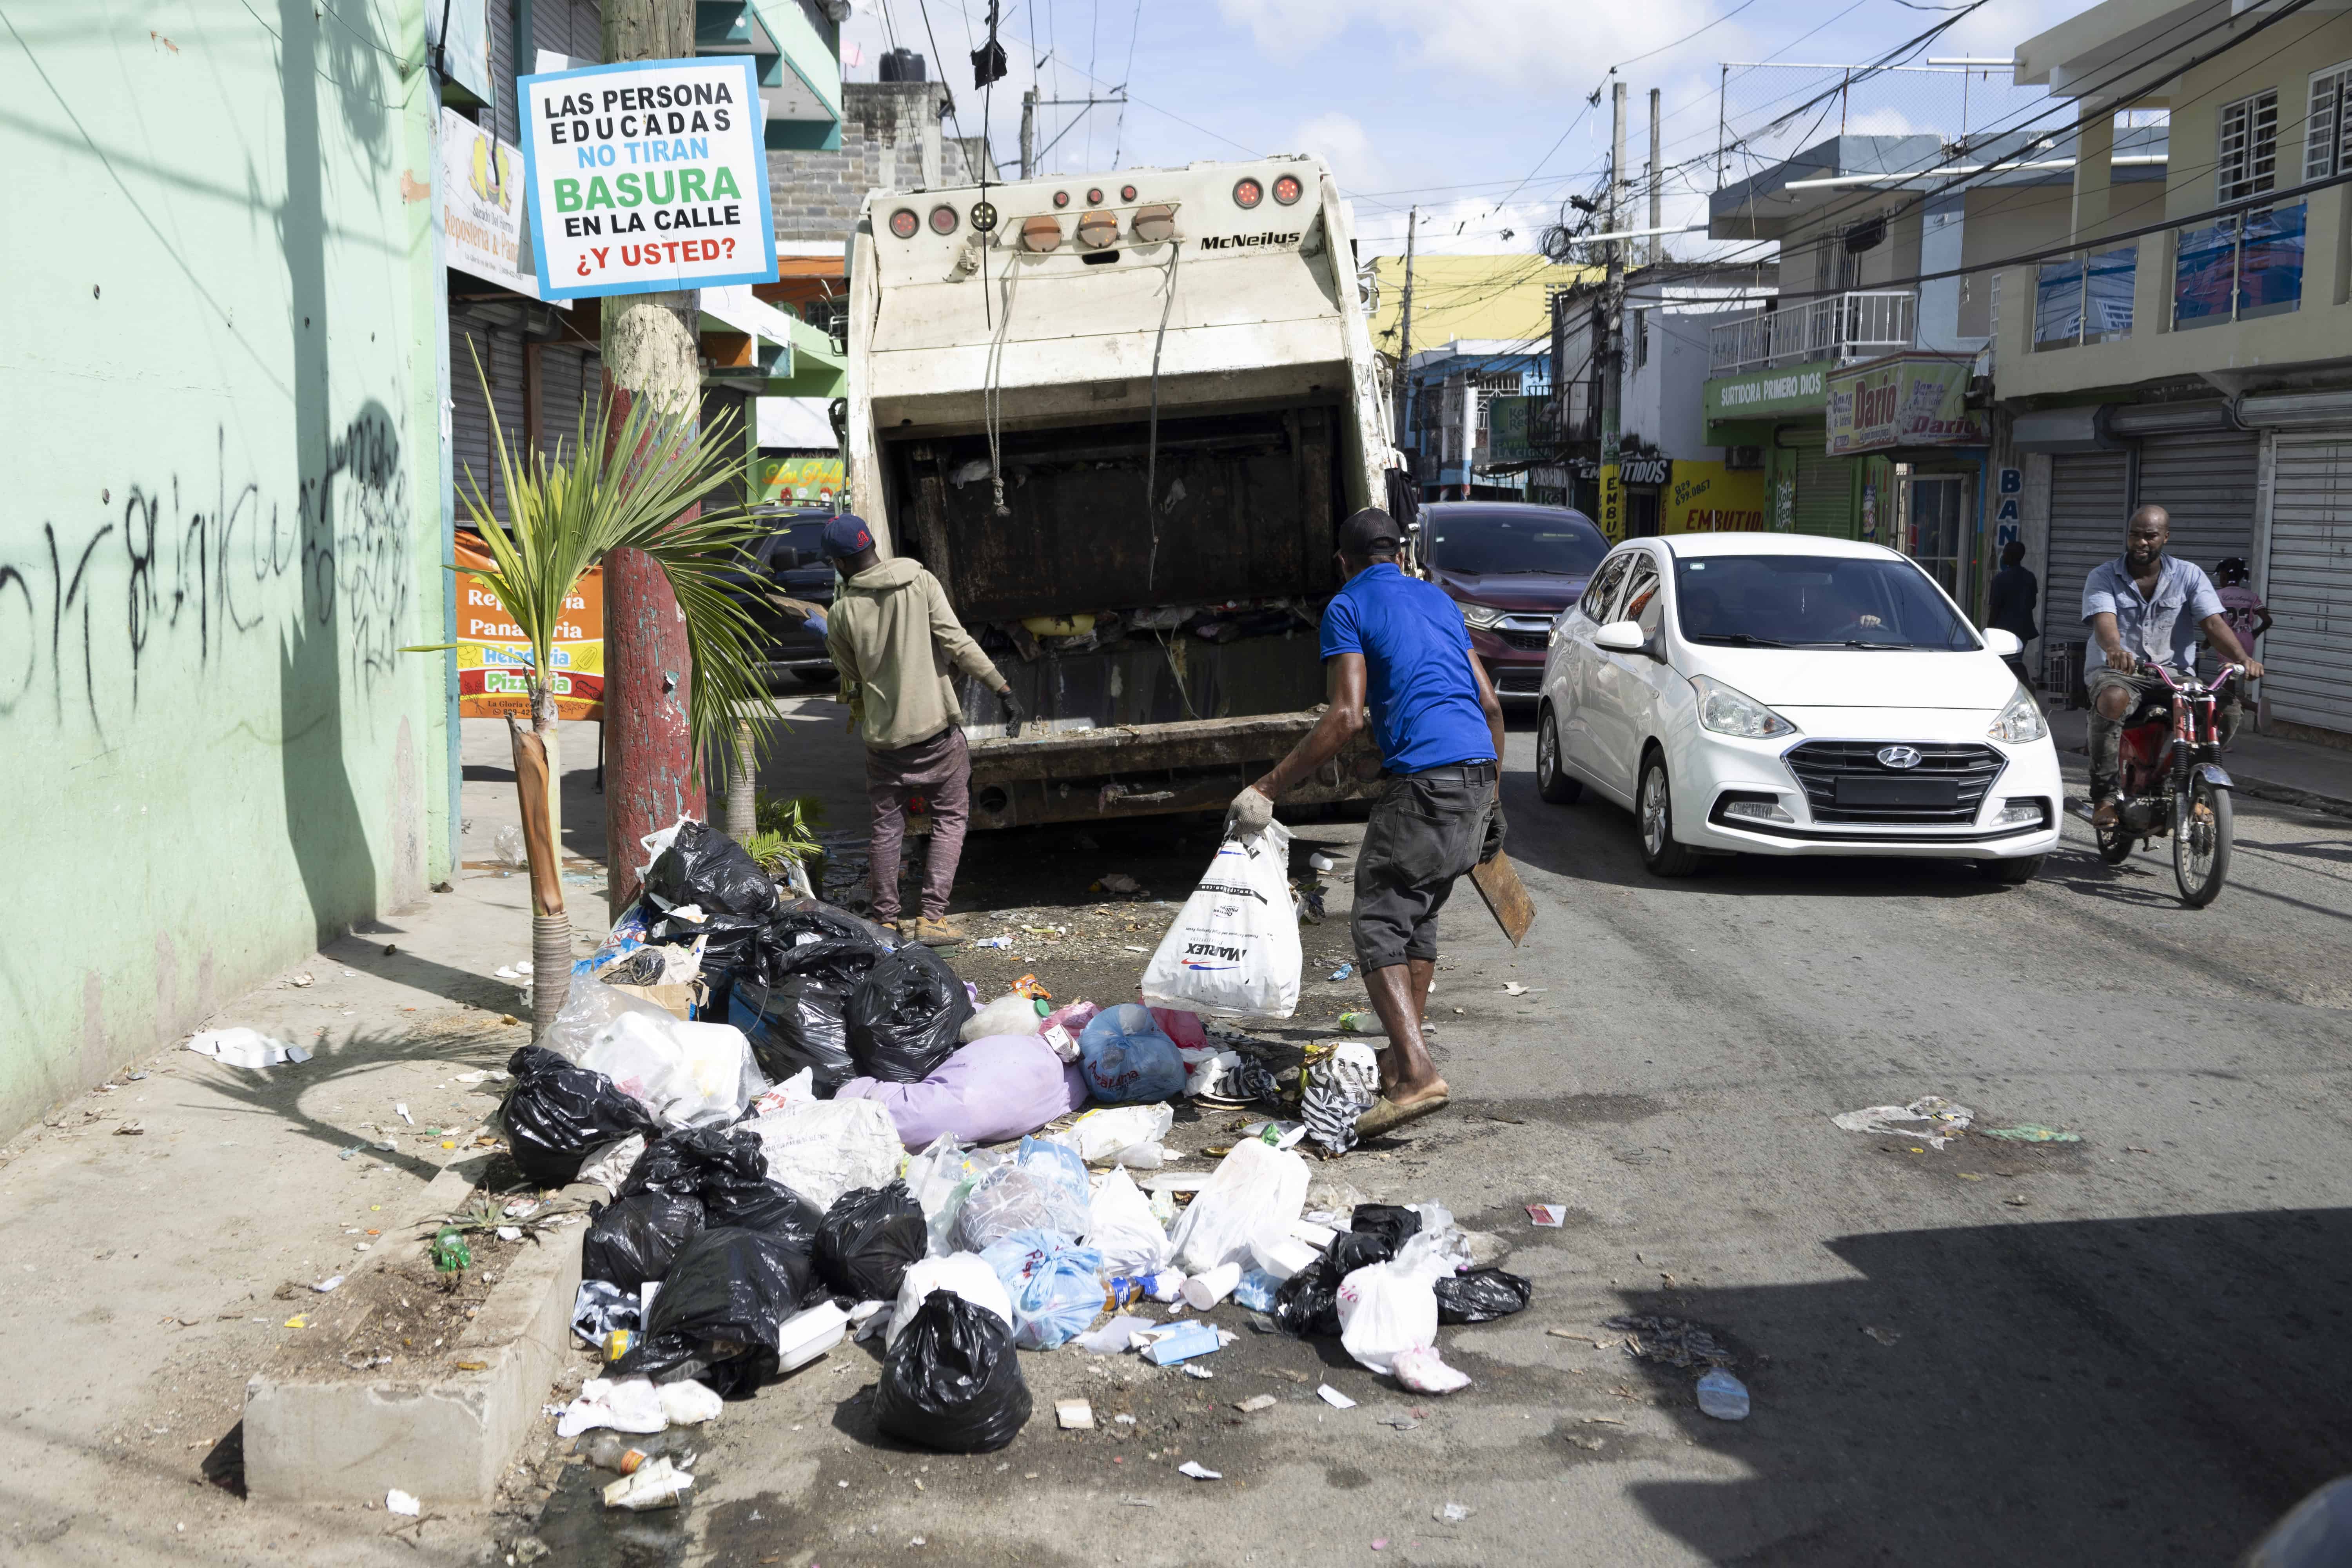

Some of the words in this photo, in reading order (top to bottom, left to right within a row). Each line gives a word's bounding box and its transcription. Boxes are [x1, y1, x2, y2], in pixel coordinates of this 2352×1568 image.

[544, 93, 594, 119] LAS
[603, 82, 733, 113] PERSONA
[551, 109, 731, 145] EDUCADAS
[577, 144, 616, 169] NO
[624, 137, 709, 164] TIRAN
[554, 166, 742, 213] BASURA
[472, 202, 490, 224] Sacado
[499, 215, 514, 234] Horno
[565, 215, 602, 237] EN
[610, 212, 646, 234] LA
[654, 205, 741, 230] CALLE
[492, 232, 499, 256] &
[577, 247, 610, 276] ¿Y
[621, 237, 736, 267] USTED?
[1200, 232, 1301, 250] McNeilus
[1721, 382, 1761, 407] SURTIDORA
[1764, 376, 1798, 401] PRIMERO
[1800, 372, 1821, 395] DIOS
[1854, 374, 1897, 430] Dario
[1580, 459, 1667, 484] EMTIDOS
[1675, 480, 1690, 495] 829
[470, 619, 583, 639] Panaria
[484, 645, 569, 665] Heladia
[487, 673, 569, 691] Pizzia
[1185, 943, 1248, 962] MARLEX
